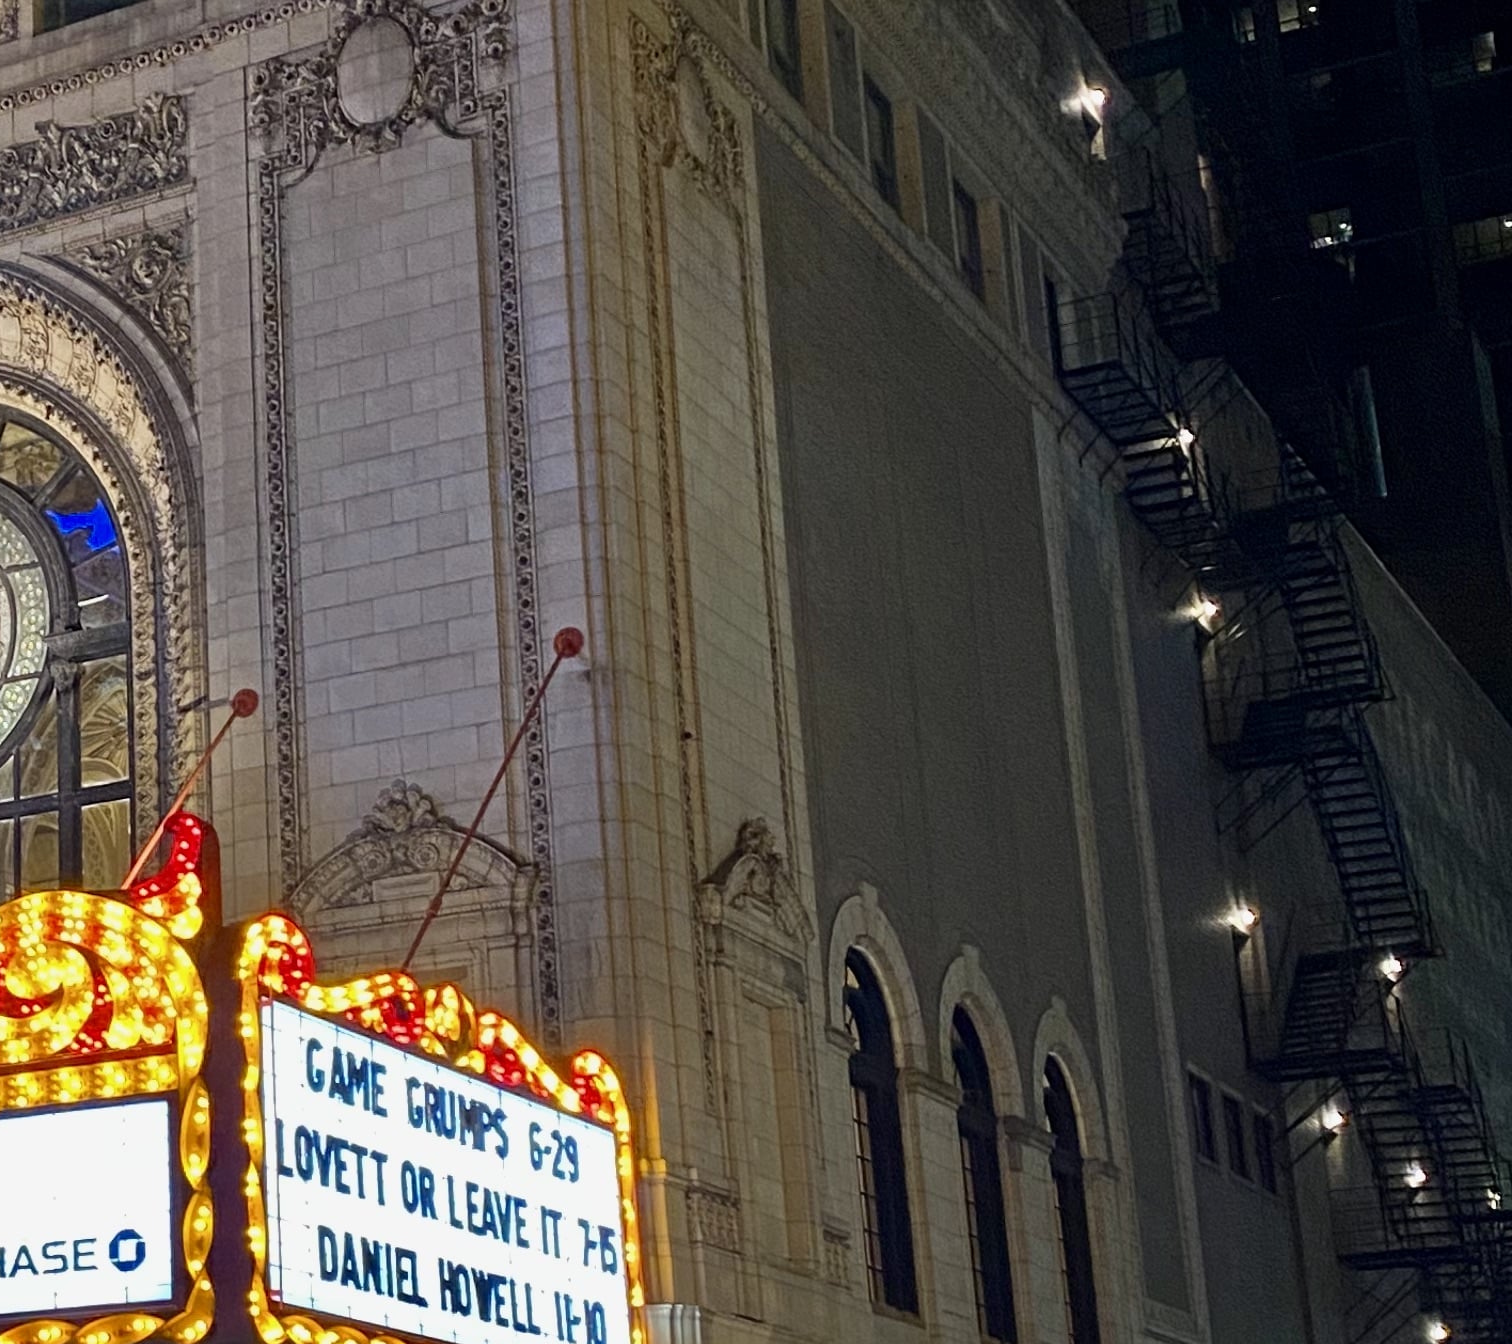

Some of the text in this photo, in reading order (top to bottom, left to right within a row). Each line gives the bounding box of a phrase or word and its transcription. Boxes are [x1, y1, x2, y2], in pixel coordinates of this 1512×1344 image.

[305, 1037, 580, 1184] GAME GRUMPS 6-29
[276, 1118, 618, 1276] LOVETT OR LEAVE IT 7-15
[317, 1224, 429, 1309] DANIEL
[437, 1257, 542, 1336] HOWELL
